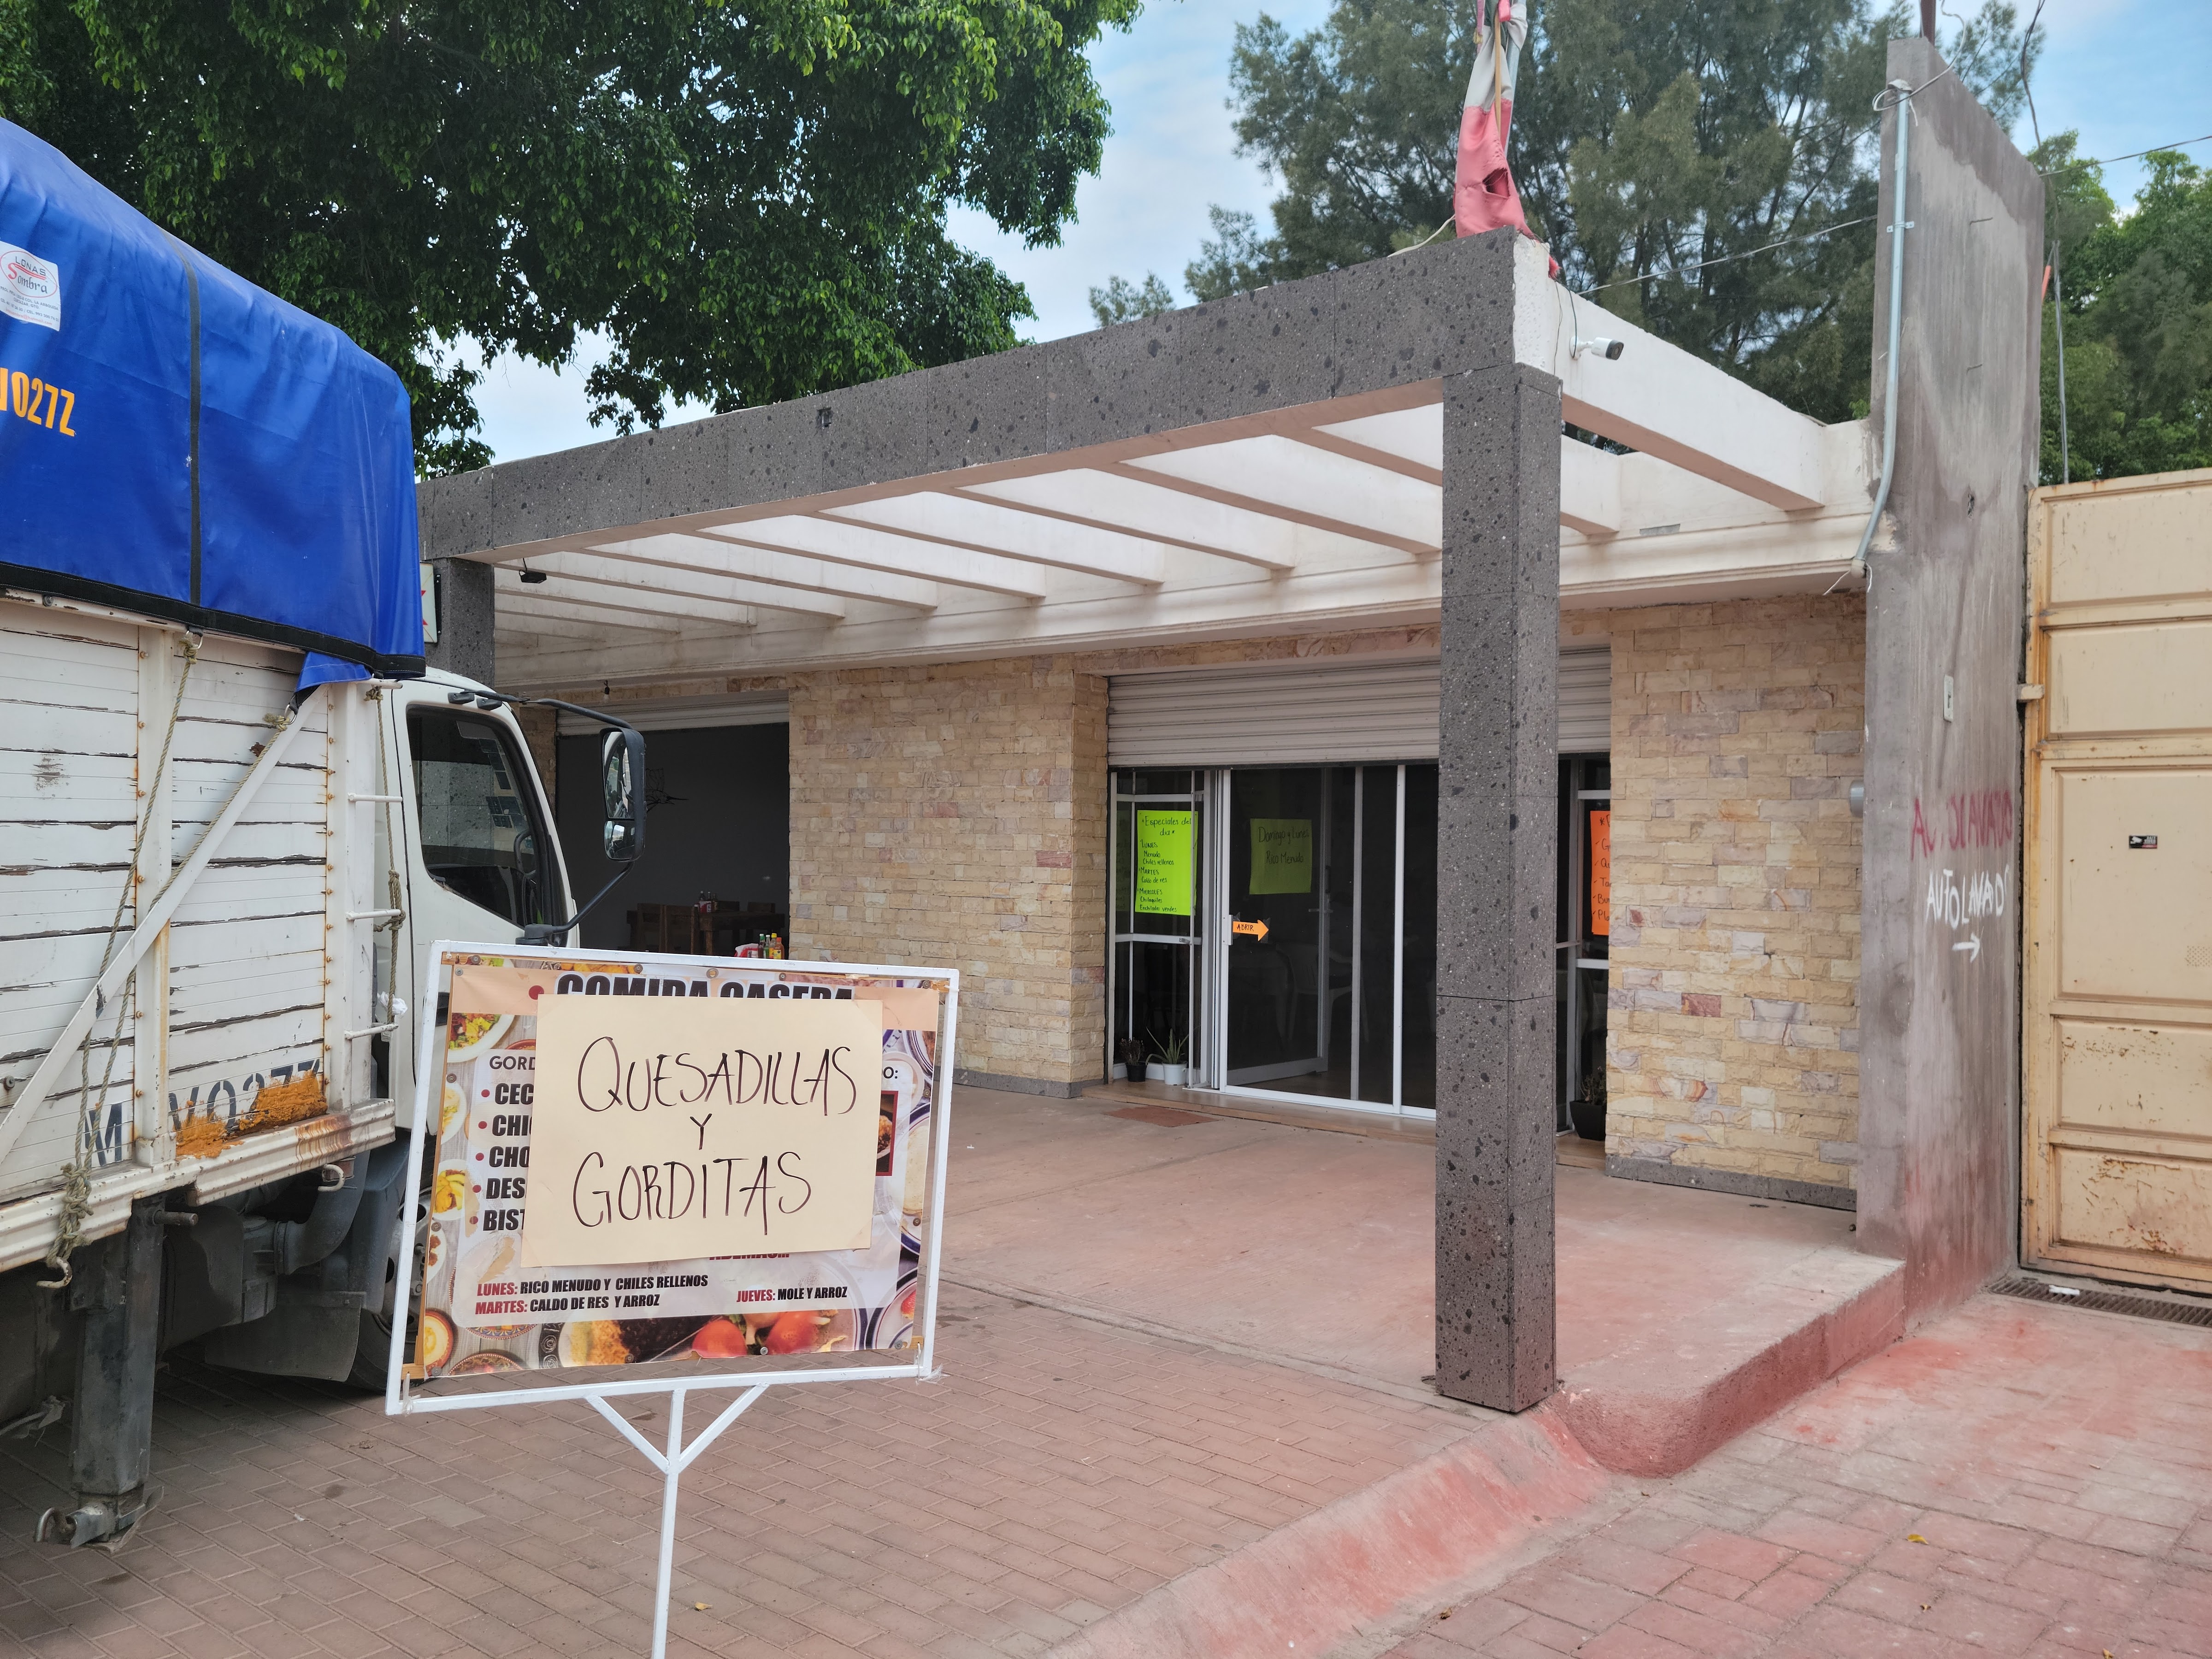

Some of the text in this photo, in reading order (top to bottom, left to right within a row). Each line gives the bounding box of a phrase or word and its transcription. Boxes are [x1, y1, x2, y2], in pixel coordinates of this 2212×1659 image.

[16, 256, 46, 276] LONAS
[1145, 815, 1179, 828] Especiales
[1258, 827, 1286, 846] Domingo
[1267, 850, 1304, 864] Rico Menudo
[1140, 867, 1159, 875] MARTES
[578, 1036, 856, 1116] QUESADILLAS
[492, 1114, 532, 1136] CHI
[690, 1113, 712, 1150] Y
[573, 1151, 811, 1235] GORDITAS
[477, 1274, 709, 1296] LUNES: RICO MENUDO Y CHILES RELLENOS
[736, 1286, 848, 1303] JUEVES: MOLE Y ARROZ
[475, 1294, 661, 1315] MARTES: CALDO DE RES Y ARROZ
